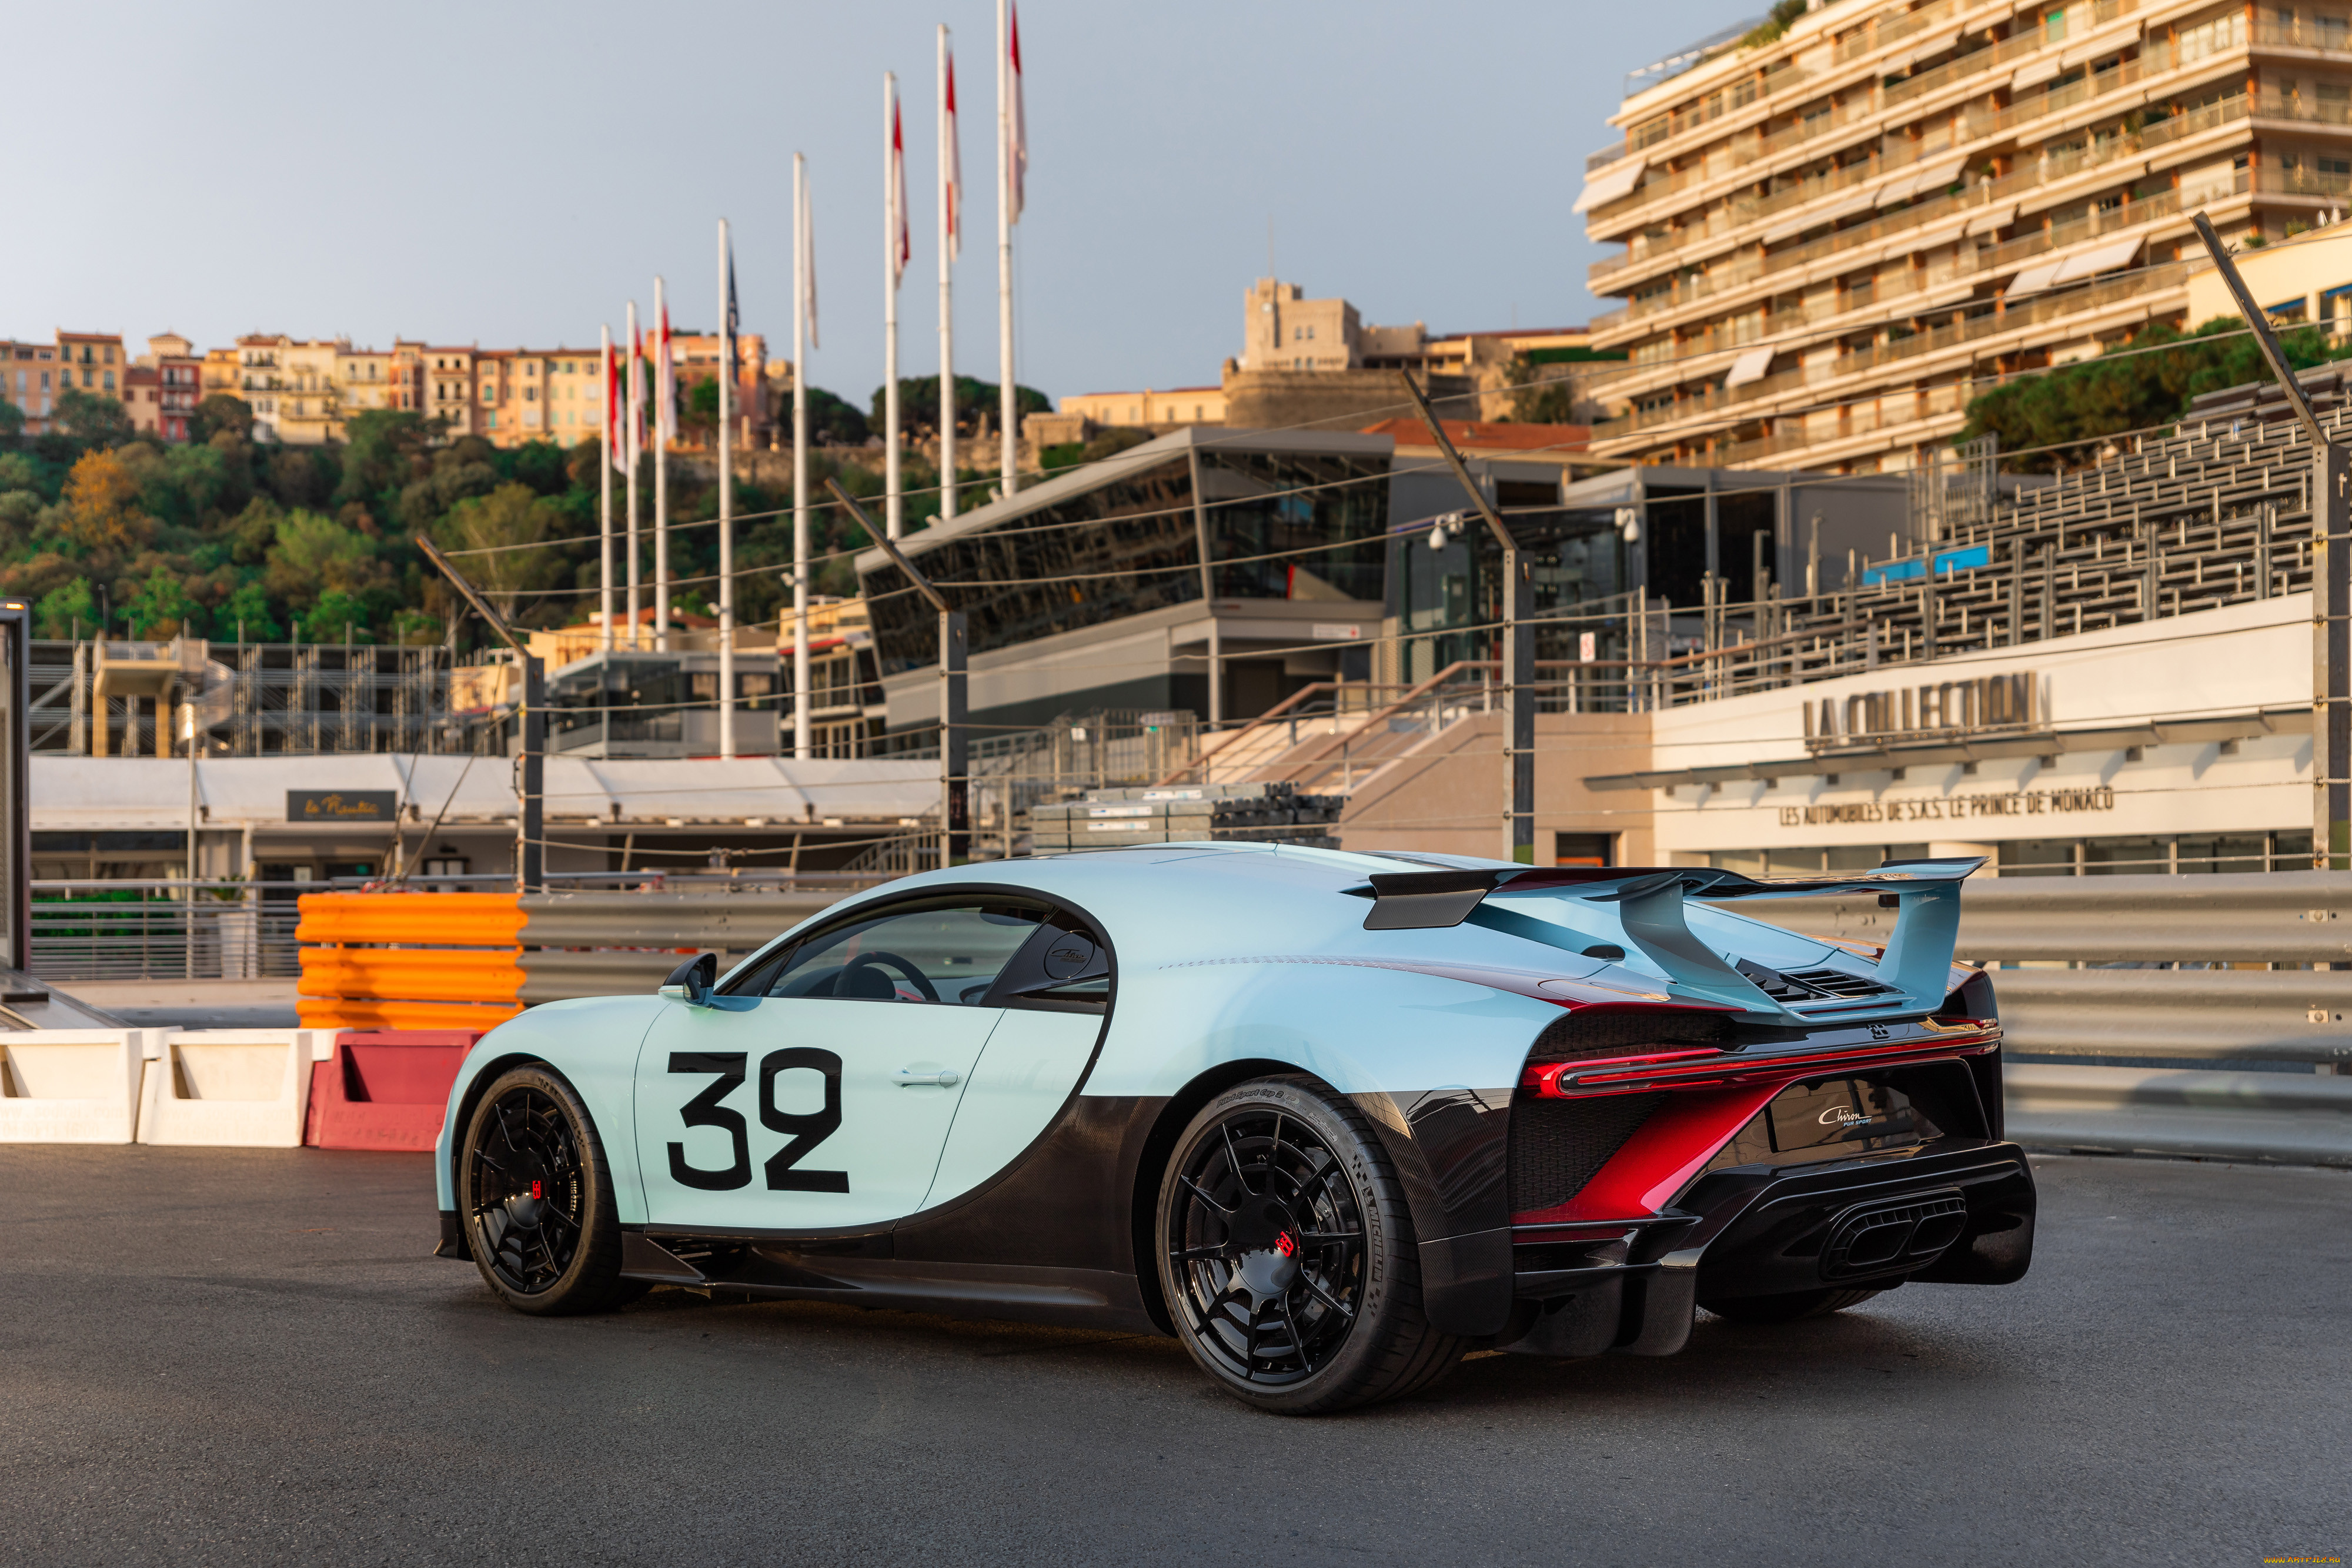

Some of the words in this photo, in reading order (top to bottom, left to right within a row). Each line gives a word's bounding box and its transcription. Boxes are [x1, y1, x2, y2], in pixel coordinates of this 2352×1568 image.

[1780, 806, 1799, 825] LES
[1950, 795, 1966, 818] LE
[1972, 792, 2020, 816] PRINCE
[2027, 791, 2045, 814] DE
[2052, 785, 2114, 812] MONACO
[1217, 1094, 1236, 1108] Pilot
[1235, 1089, 1260, 1100] Sport
[1259, 1089, 1275, 1098] Cup
[1818, 1105, 1872, 1125] Chiron
[667, 1047, 850, 1193] 32
[1369, 1206, 1382, 1281] MICHELIN
